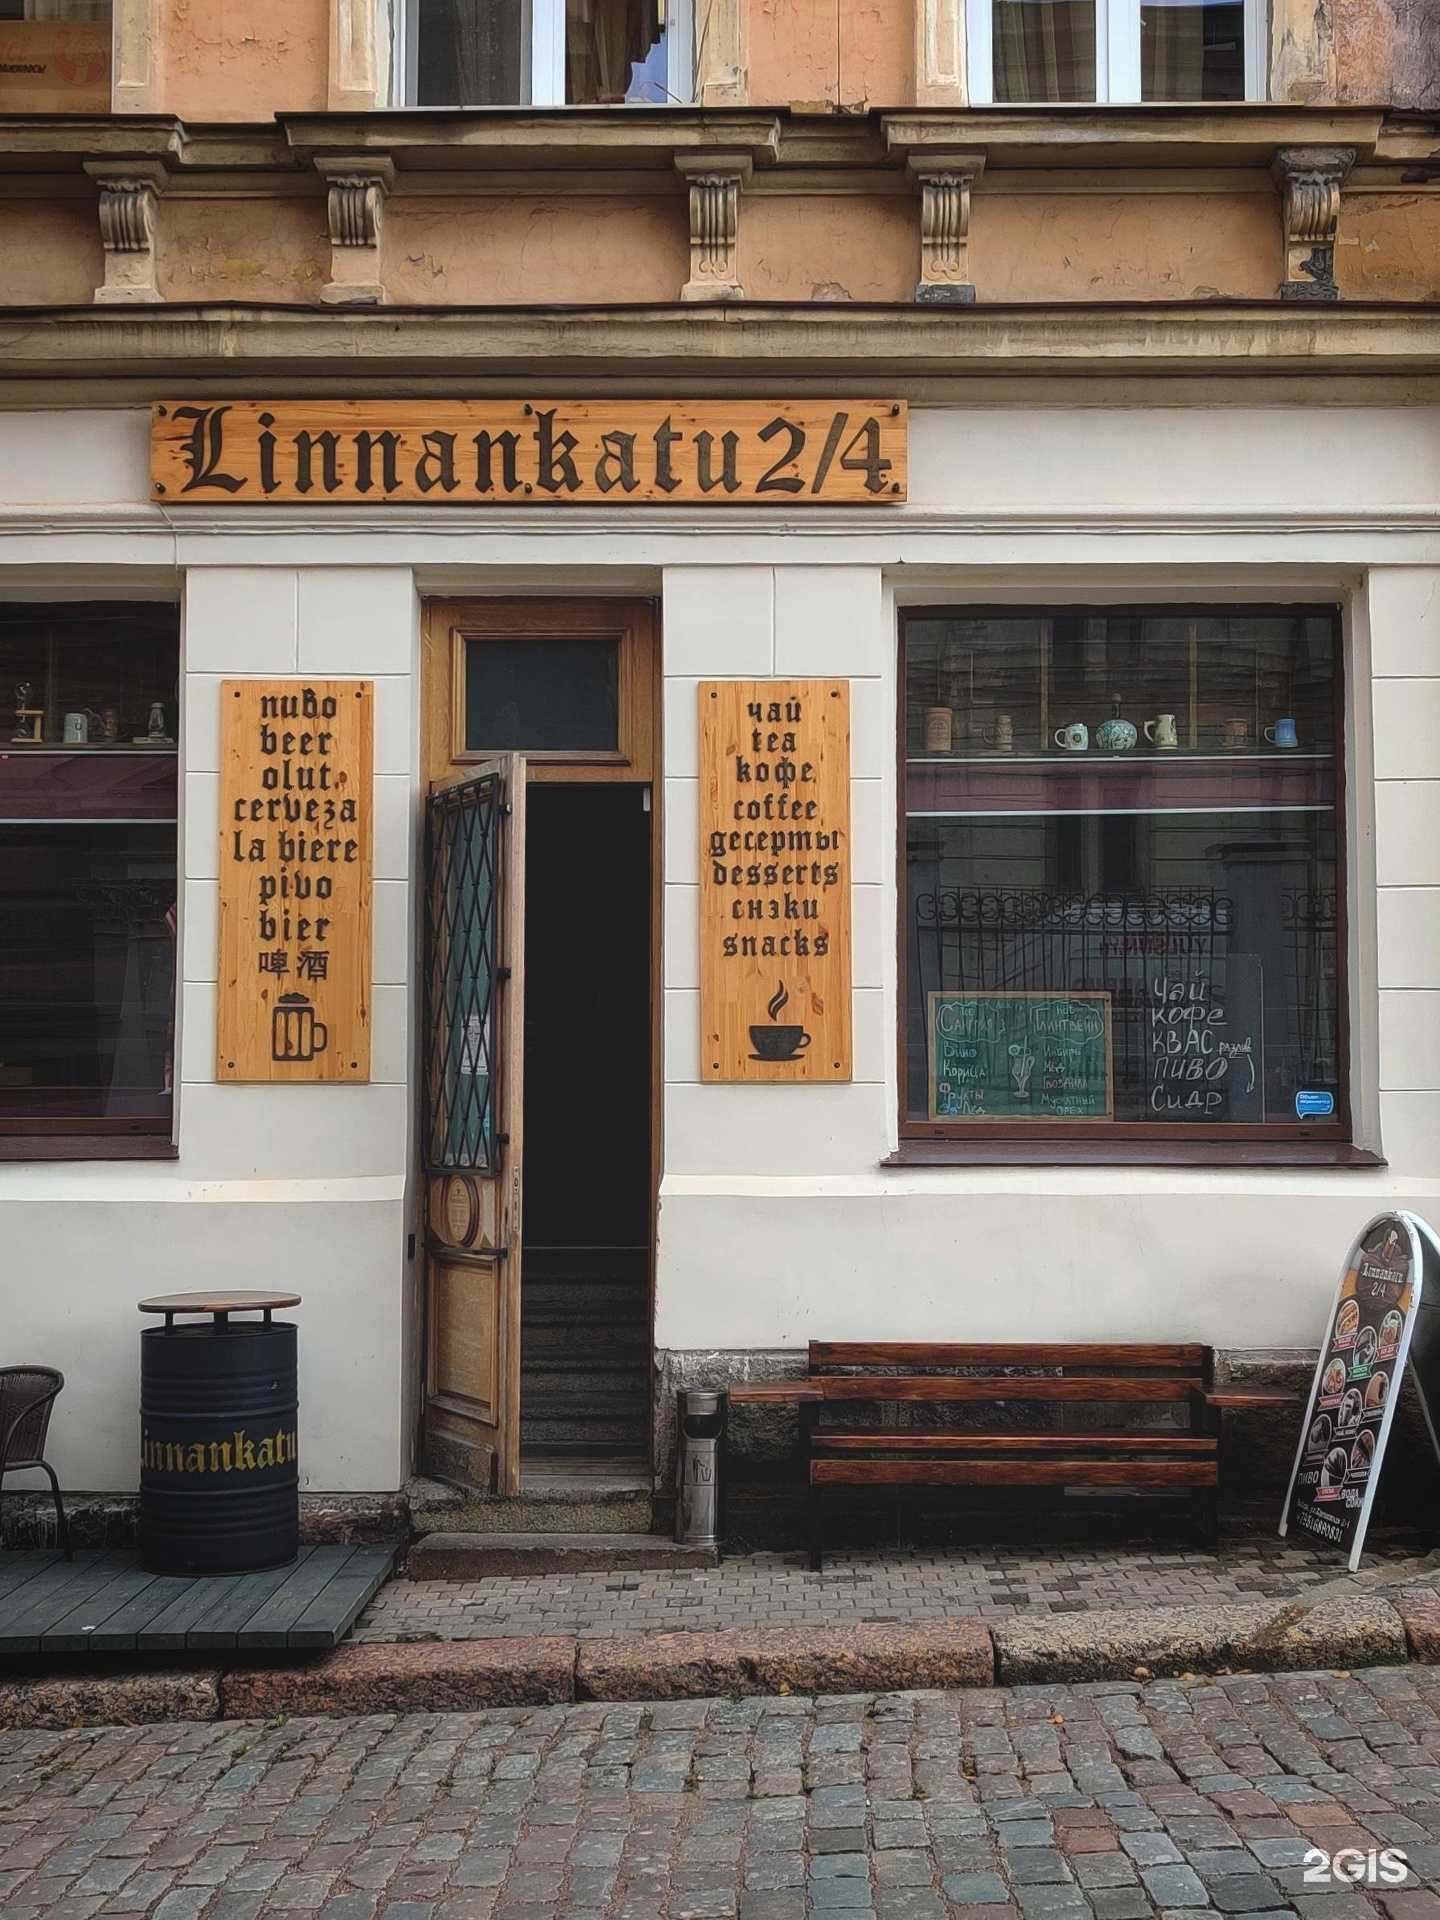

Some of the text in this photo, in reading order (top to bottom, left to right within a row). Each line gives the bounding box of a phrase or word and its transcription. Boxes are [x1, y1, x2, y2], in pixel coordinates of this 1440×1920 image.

[172, 405, 892, 494] Linnankatu 2/4
[747, 696, 802, 724] чай
[260, 724, 333, 756] beer
[751, 727, 798, 753] tea
[261, 759, 333, 791] olut
[735, 755, 814, 789] кофе
[233, 794, 358, 829] cerveza
[733, 793, 818, 822] coffee
[233, 830, 359, 863] la biere
[710, 829, 840, 857] десерты
[259, 866, 332, 905] pivo
[712, 860, 840, 887] desserts
[731, 893, 820, 920] снэки
[259, 908, 331, 942] bier
[723, 929, 829, 958] snacks
[258, 948, 330, 982] 啤酒
[1152, 1029, 1214, 1056] КВАС
[143, 1427, 296, 1473] innankatu
